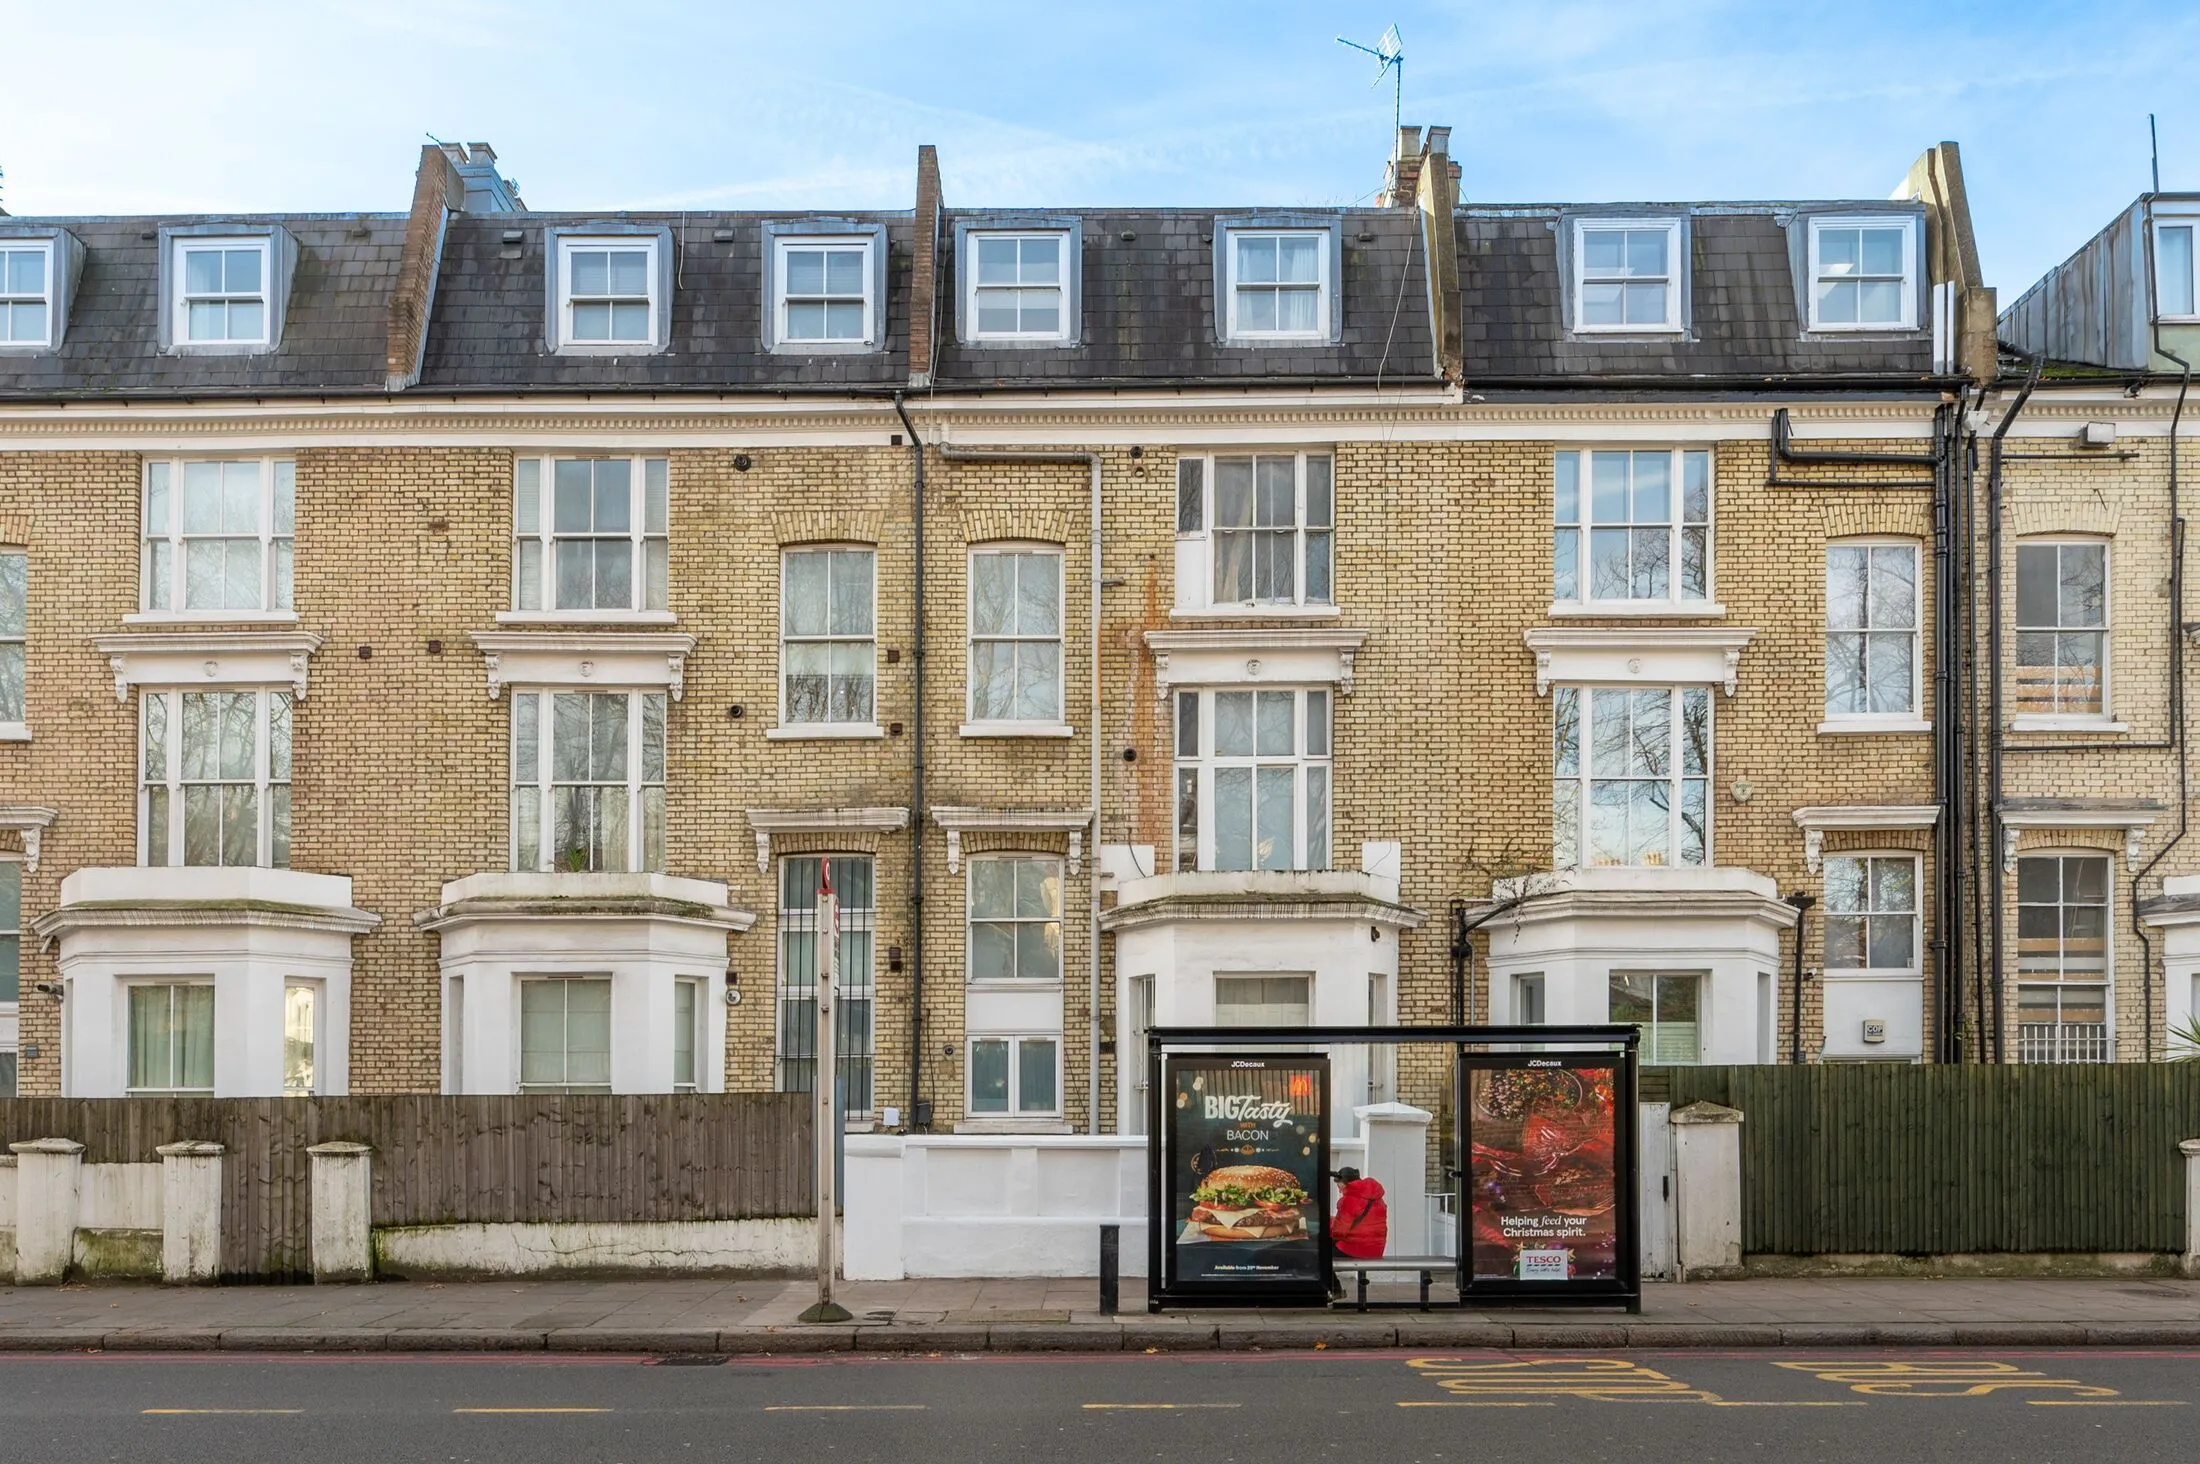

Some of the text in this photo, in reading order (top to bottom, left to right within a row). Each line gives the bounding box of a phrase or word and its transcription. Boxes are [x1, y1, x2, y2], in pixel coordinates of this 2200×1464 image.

[1204, 1094, 1294, 1128] BIG Tasty
[1226, 1130, 1269, 1141] BACON
[1501, 1216, 1587, 1227] Helping feed your
[1503, 1227, 1586, 1238] Christmas spirit.
[1406, 1358, 1723, 1402] STOP
[1771, 1361, 2121, 1396] BUS
